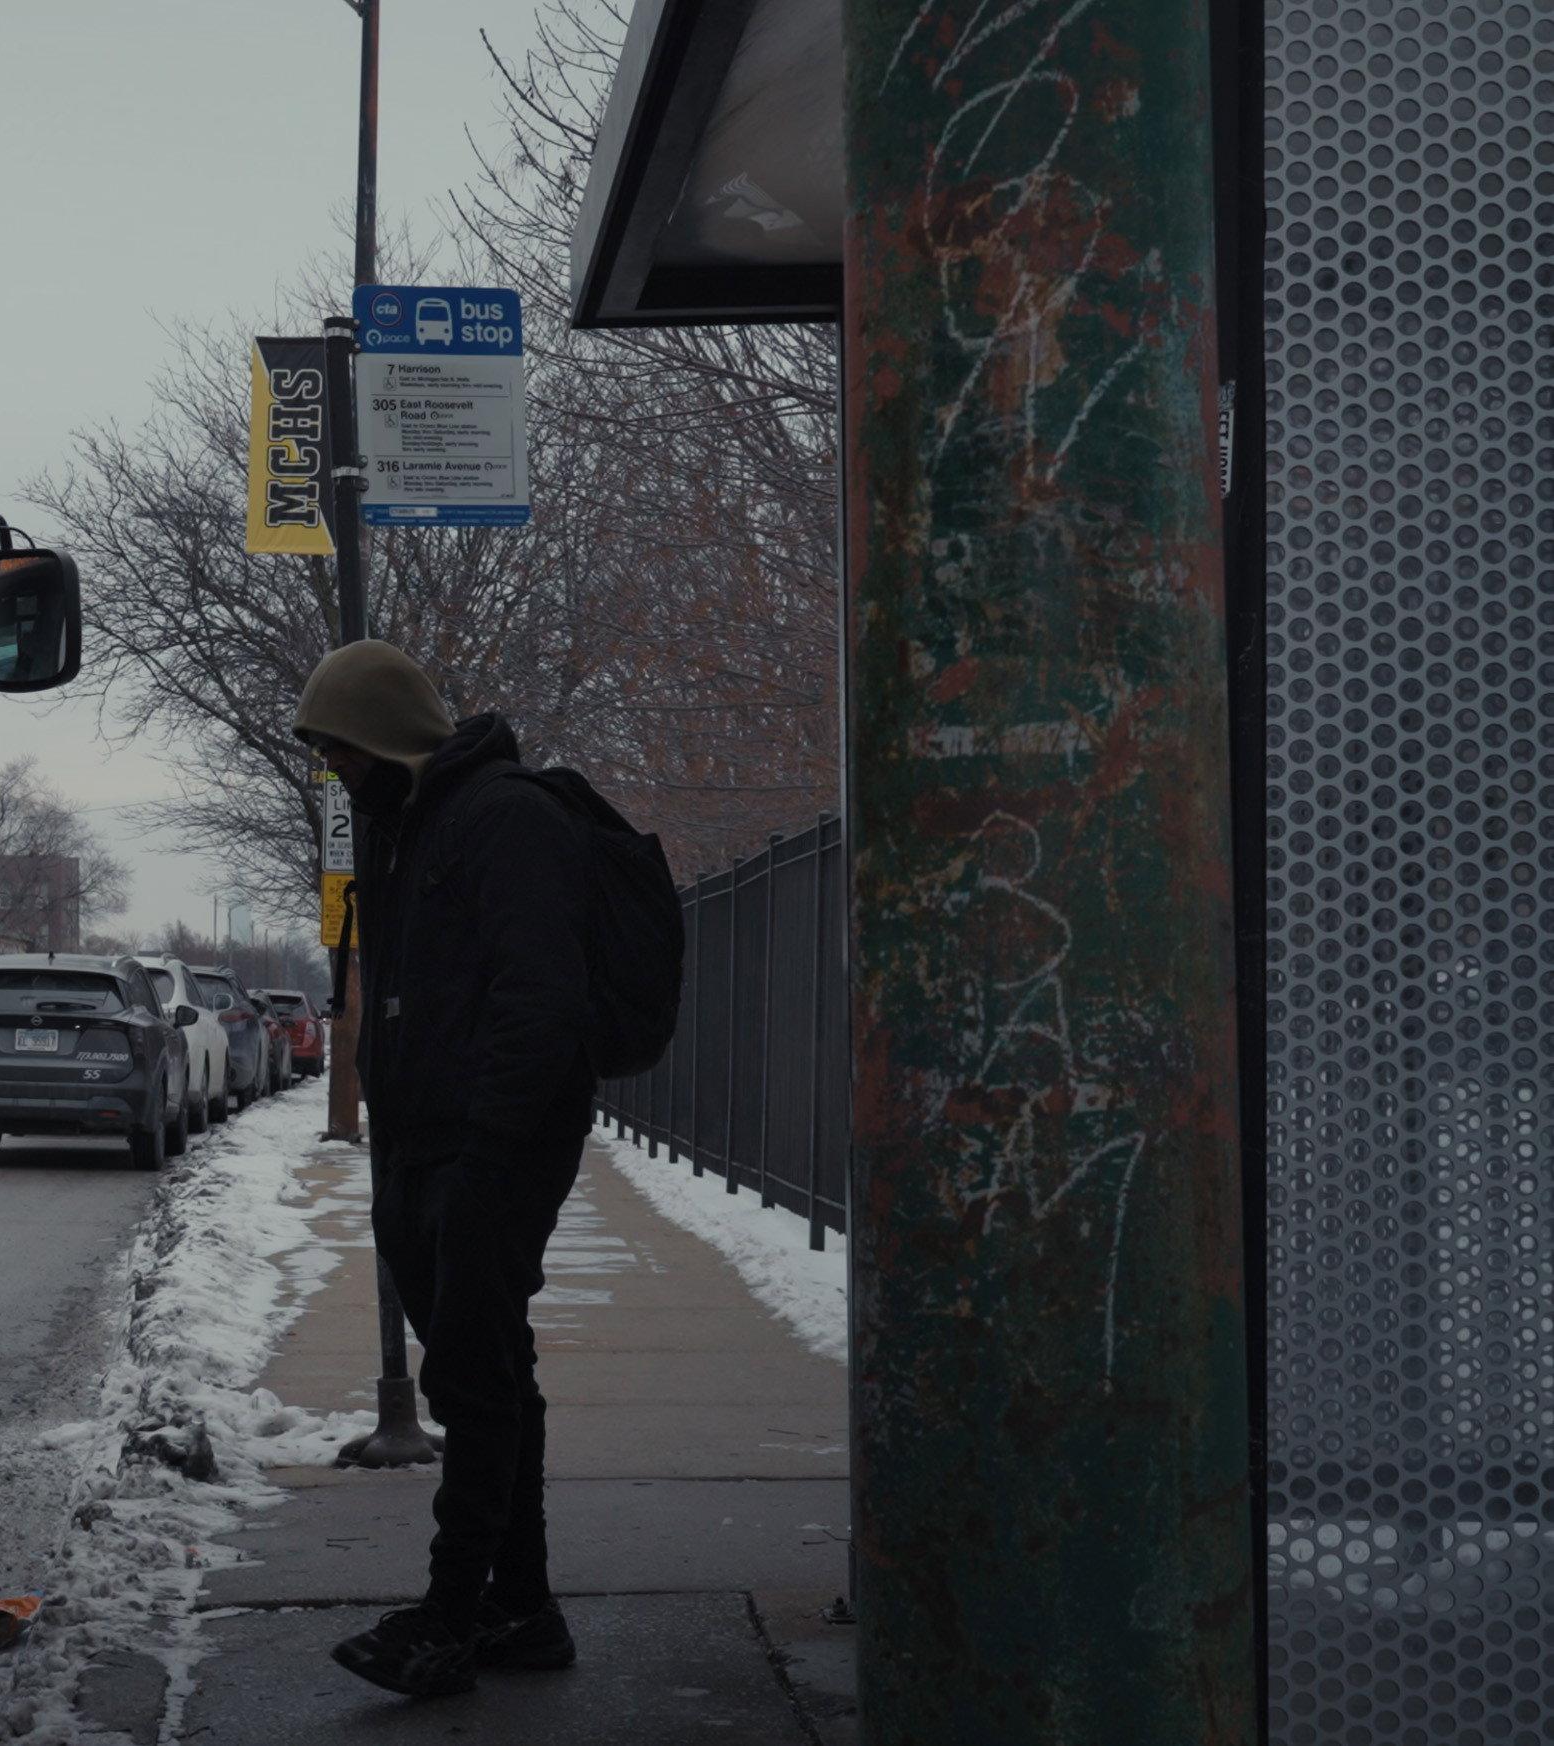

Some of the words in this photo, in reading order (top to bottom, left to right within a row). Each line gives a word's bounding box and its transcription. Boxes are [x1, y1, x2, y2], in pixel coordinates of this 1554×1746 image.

[376, 303, 398, 315] cta
[461, 298, 504, 320] bus
[461, 322, 514, 349] stop
[387, 364, 395, 375] 7
[398, 364, 441, 373] Harrison
[372, 399, 397, 411] 305
[400, 400, 421, 409] East
[425, 400, 473, 410] Roosevelt
[400, 411, 427, 420] Road
[265, 368, 322, 527] MCHS
[377, 461, 400, 472] 316
[402, 462, 442, 470] Laramie
[445, 462, 481, 471] Avenue
